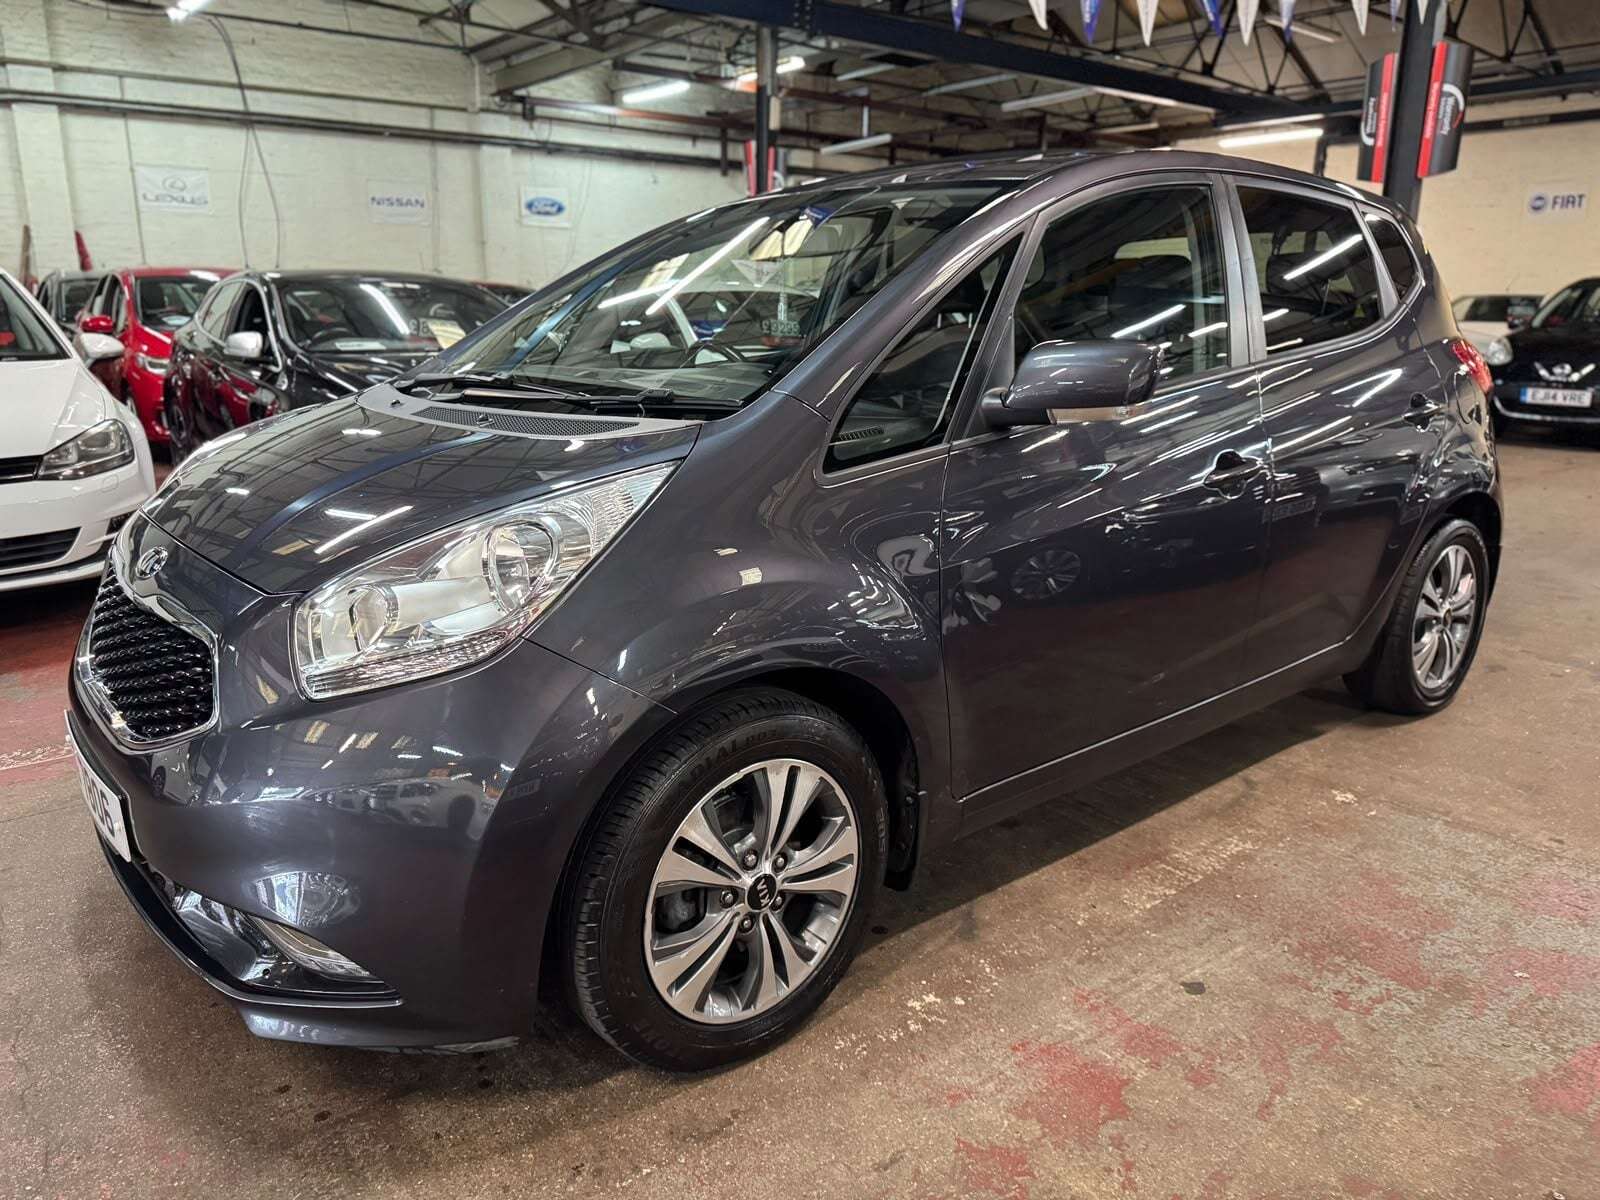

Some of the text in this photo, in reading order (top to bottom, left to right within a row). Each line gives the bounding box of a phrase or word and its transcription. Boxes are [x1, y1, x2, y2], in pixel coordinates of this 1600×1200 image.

[371, 196, 425, 208] NISSAN
[1552, 194, 1585, 210] FIAT
[756, 878, 770, 907] KIA
